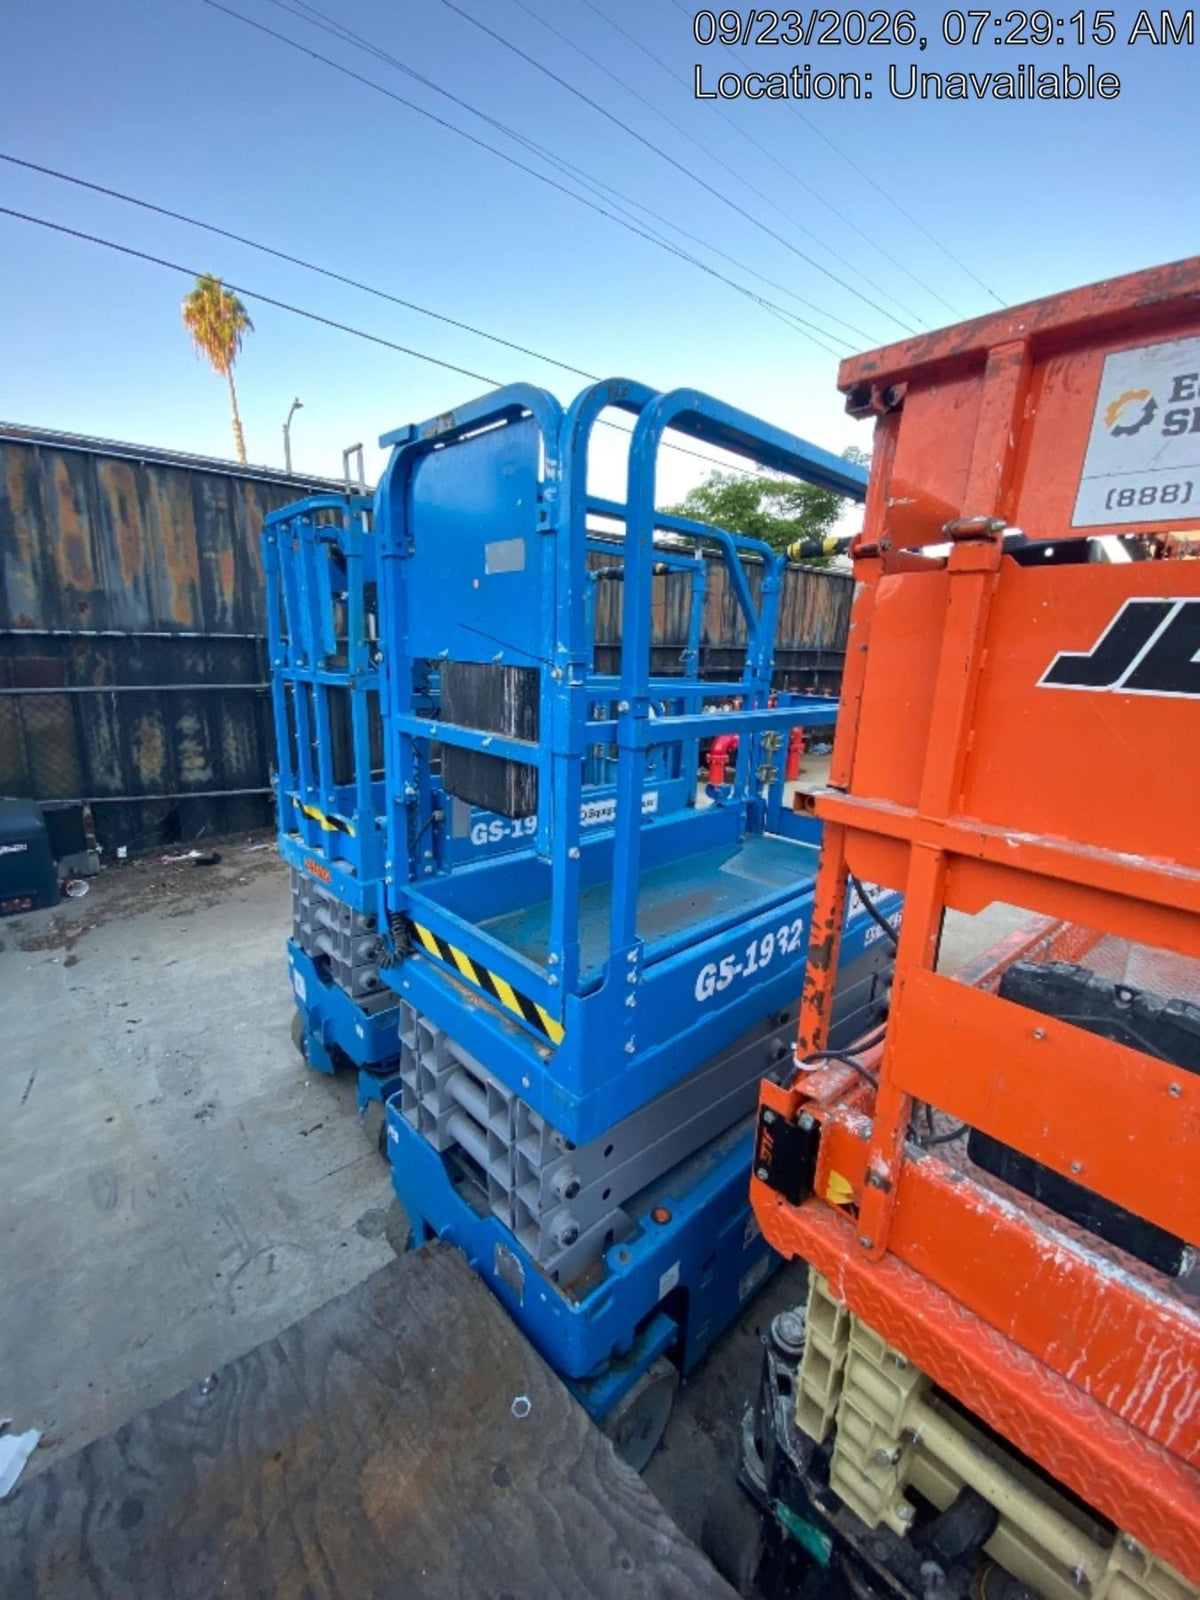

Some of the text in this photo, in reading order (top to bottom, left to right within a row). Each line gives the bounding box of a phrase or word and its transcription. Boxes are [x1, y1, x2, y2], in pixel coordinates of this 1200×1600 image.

[1167, 373, 1200, 403] E
[1105, 481, 1193, 510] (888)
[694, 918, 803, 1002] GS-1932
